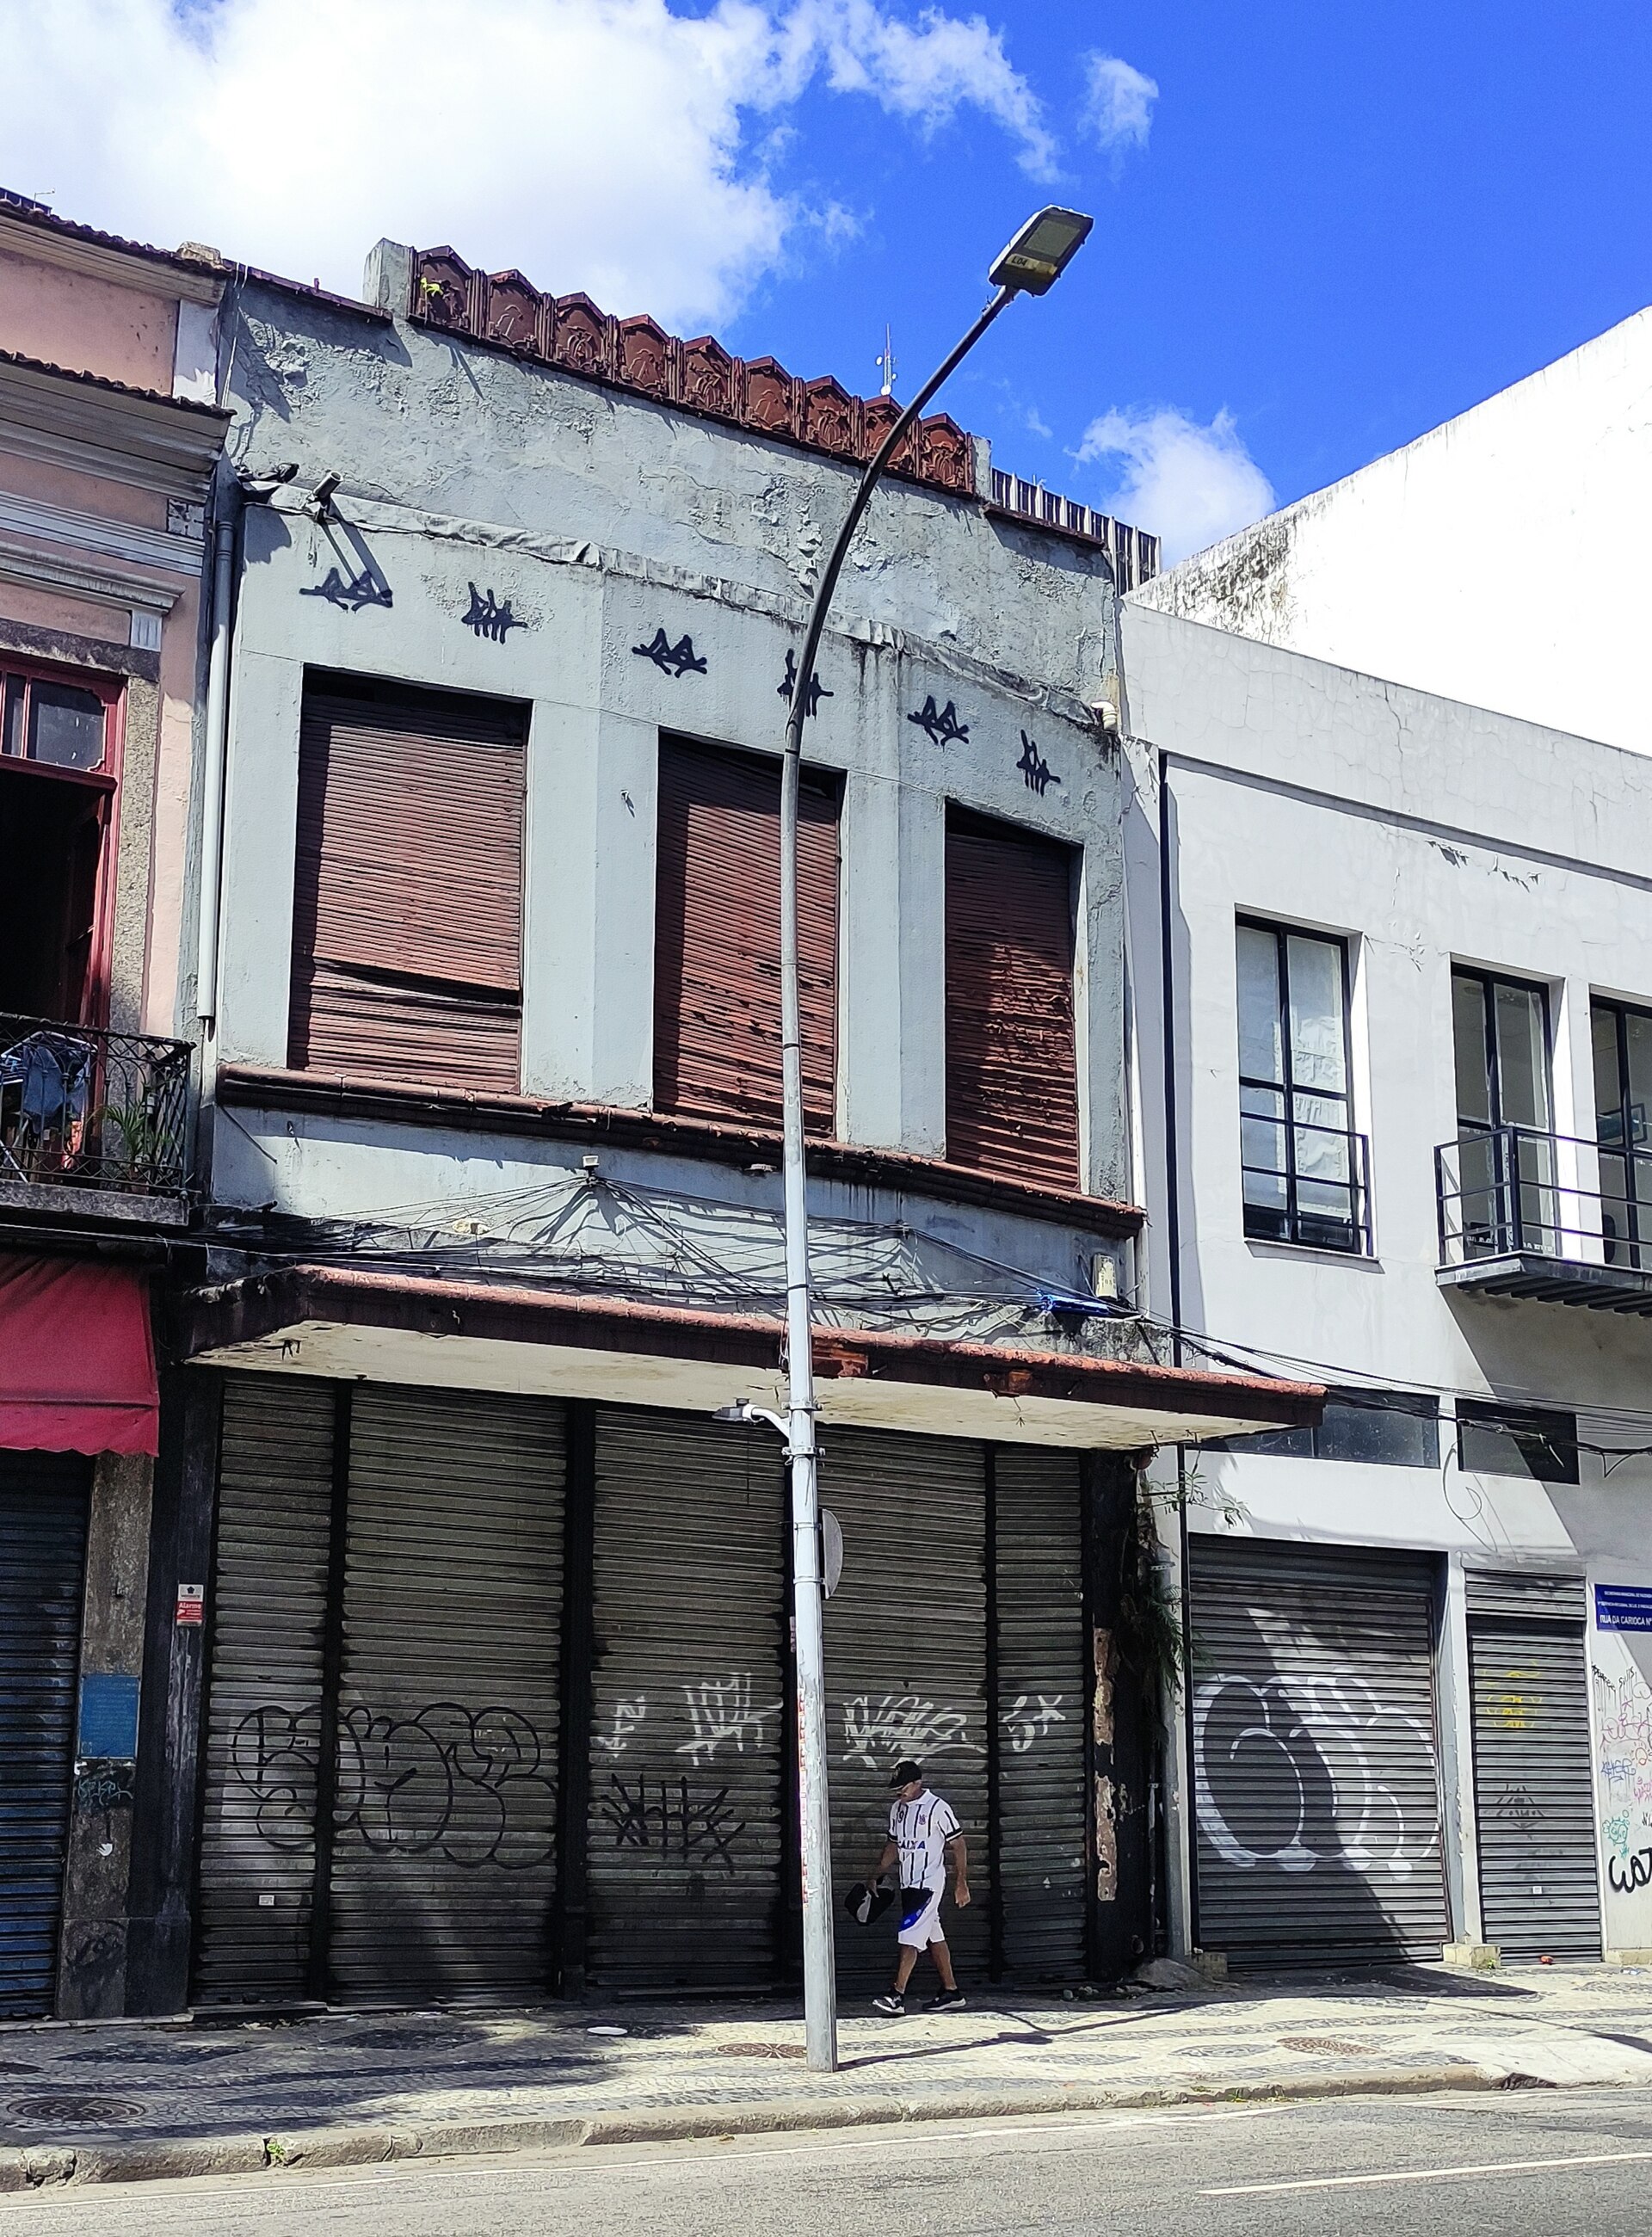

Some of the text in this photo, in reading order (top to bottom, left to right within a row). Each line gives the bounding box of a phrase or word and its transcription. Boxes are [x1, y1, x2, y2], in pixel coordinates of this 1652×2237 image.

[1600, 1614, 1612, 1624] RUA
[1612, 1615, 1620, 1624] DA
[1620, 1616, 1645, 1626] CARIOCA
[897, 1840, 926, 1850] AIXA
